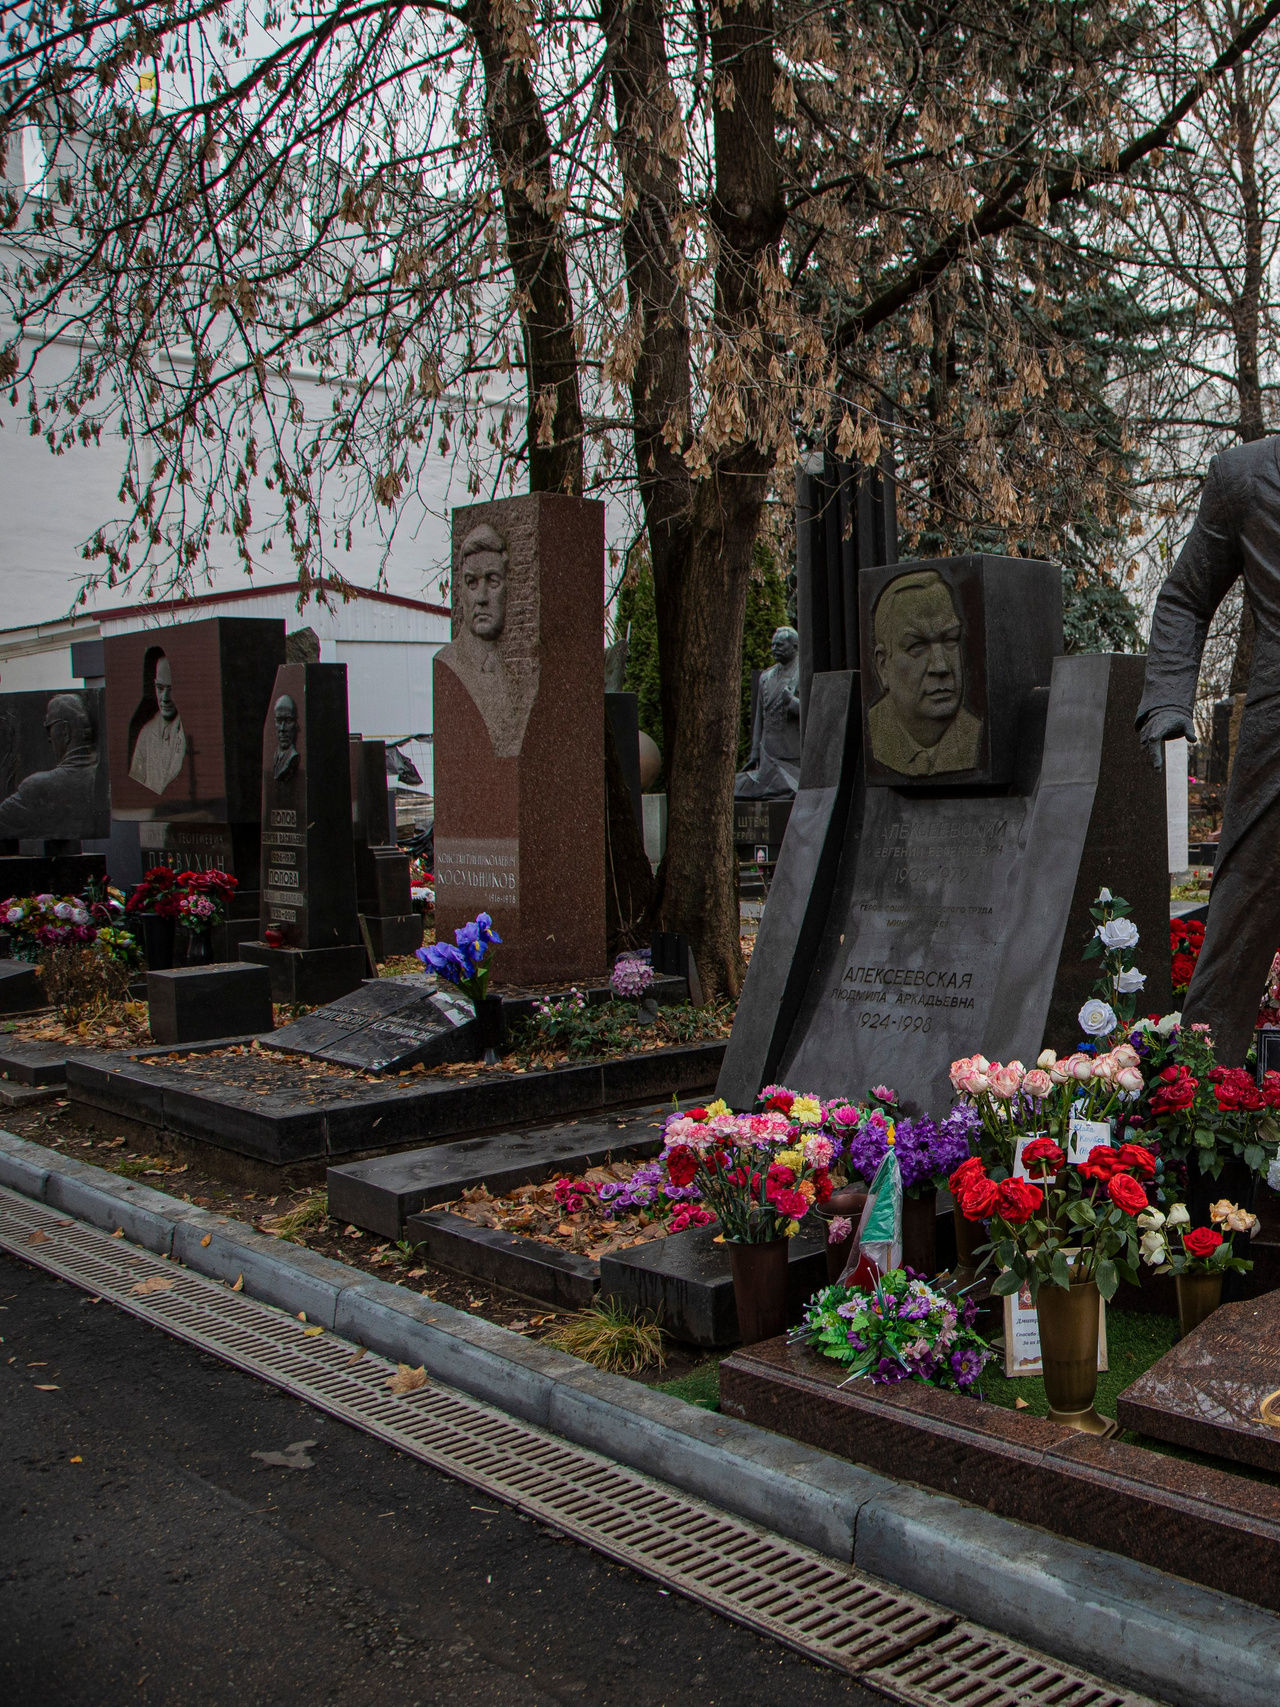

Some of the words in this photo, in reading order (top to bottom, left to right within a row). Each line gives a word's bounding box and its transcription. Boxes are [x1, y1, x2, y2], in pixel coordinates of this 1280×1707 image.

[272, 810, 296, 827] ПОПОВ
[148, 852, 225, 874] ПЕРВУХИН
[269, 870, 298, 886] ПОПОВА
[438, 869, 516, 890] КОСУЛЬНИКОВ
[842, 966, 974, 990] АЛЕКСЕЕВСКАЯ
[831, 988, 888, 1004] ЛЮДМИЛА
[894, 992, 976, 1010] АРКАДЬЕВНА
[856, 1011, 933, 1034] 1924-1998
